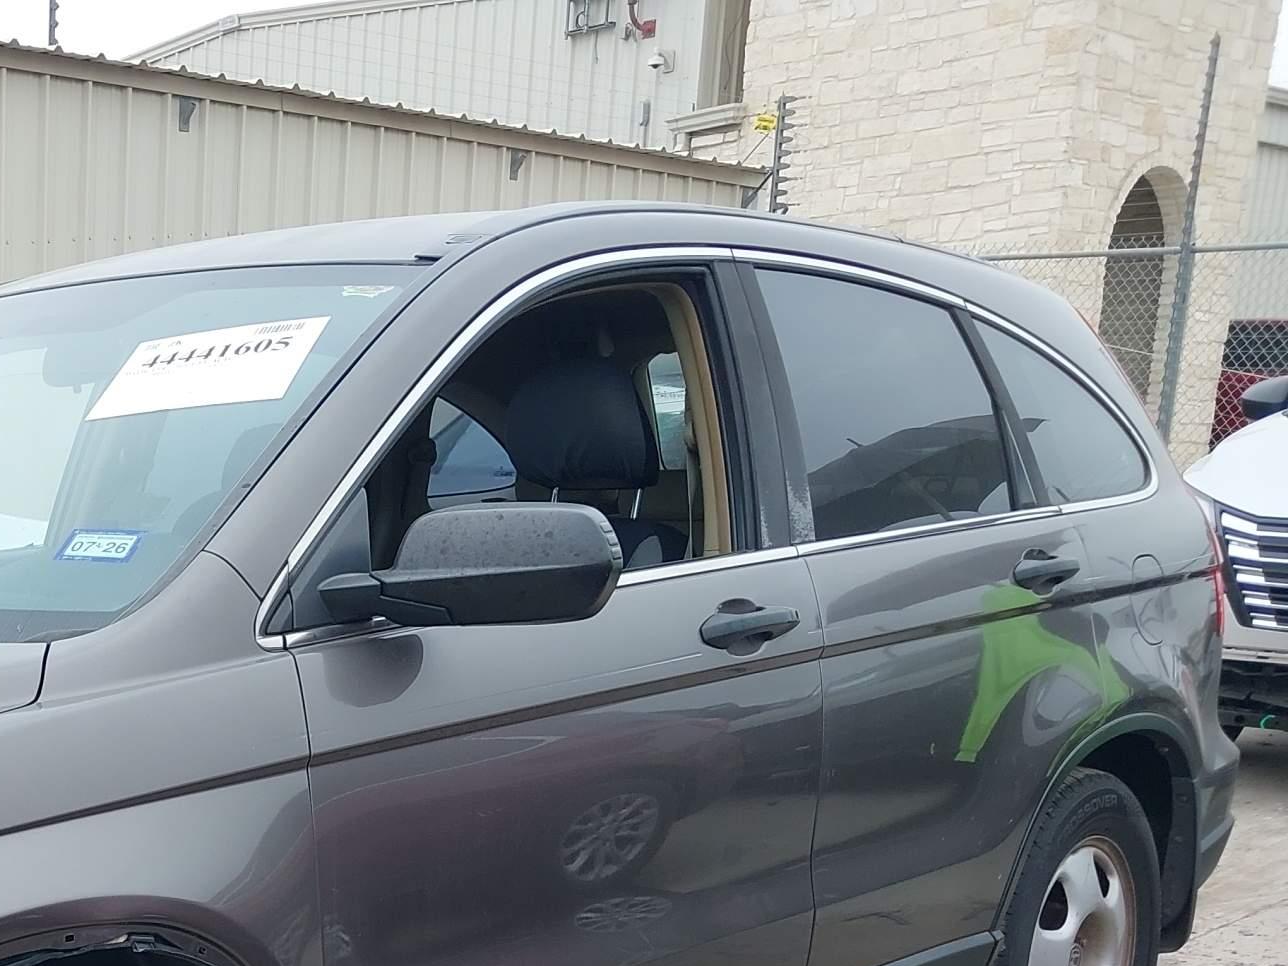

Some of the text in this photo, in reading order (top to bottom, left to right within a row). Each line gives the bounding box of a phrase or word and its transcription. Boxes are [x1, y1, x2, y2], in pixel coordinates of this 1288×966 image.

[141, 336, 294, 368] 44441605
[71, 541, 129, 554] 07 26
